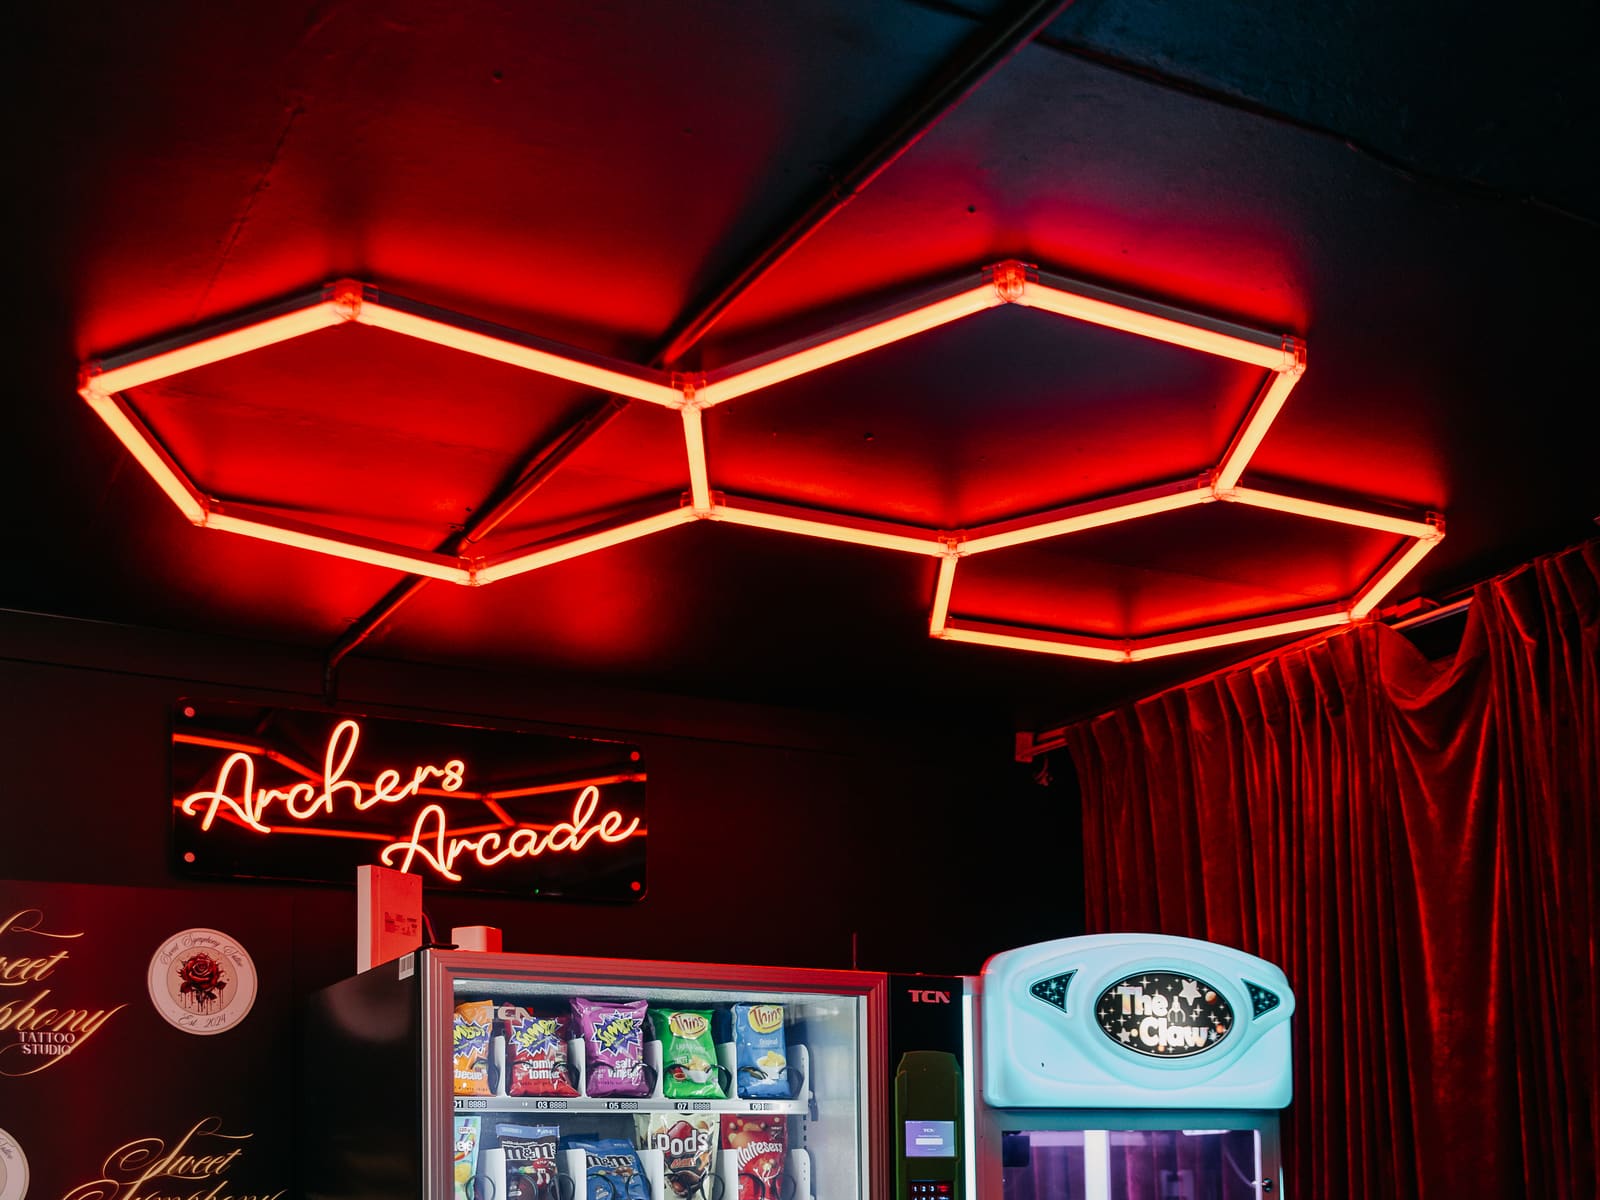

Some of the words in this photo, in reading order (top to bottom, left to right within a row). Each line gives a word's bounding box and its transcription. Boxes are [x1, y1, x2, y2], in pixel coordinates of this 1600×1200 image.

[182, 720, 464, 833] Archers
[381, 786, 639, 881] Arcade
[908, 990, 950, 1004] TCN
[1117, 985, 1168, 1017] The
[671, 1012, 706, 1031] Thins
[749, 1005, 783, 1026] Thins
[19, 1031, 76, 1044] TATTOO
[1139, 1016, 1209, 1048] Claw
[22, 1043, 72, 1056] STUDIO
[103, 1116, 254, 1185] Sweet
[656, 1130, 710, 1156] Pods
